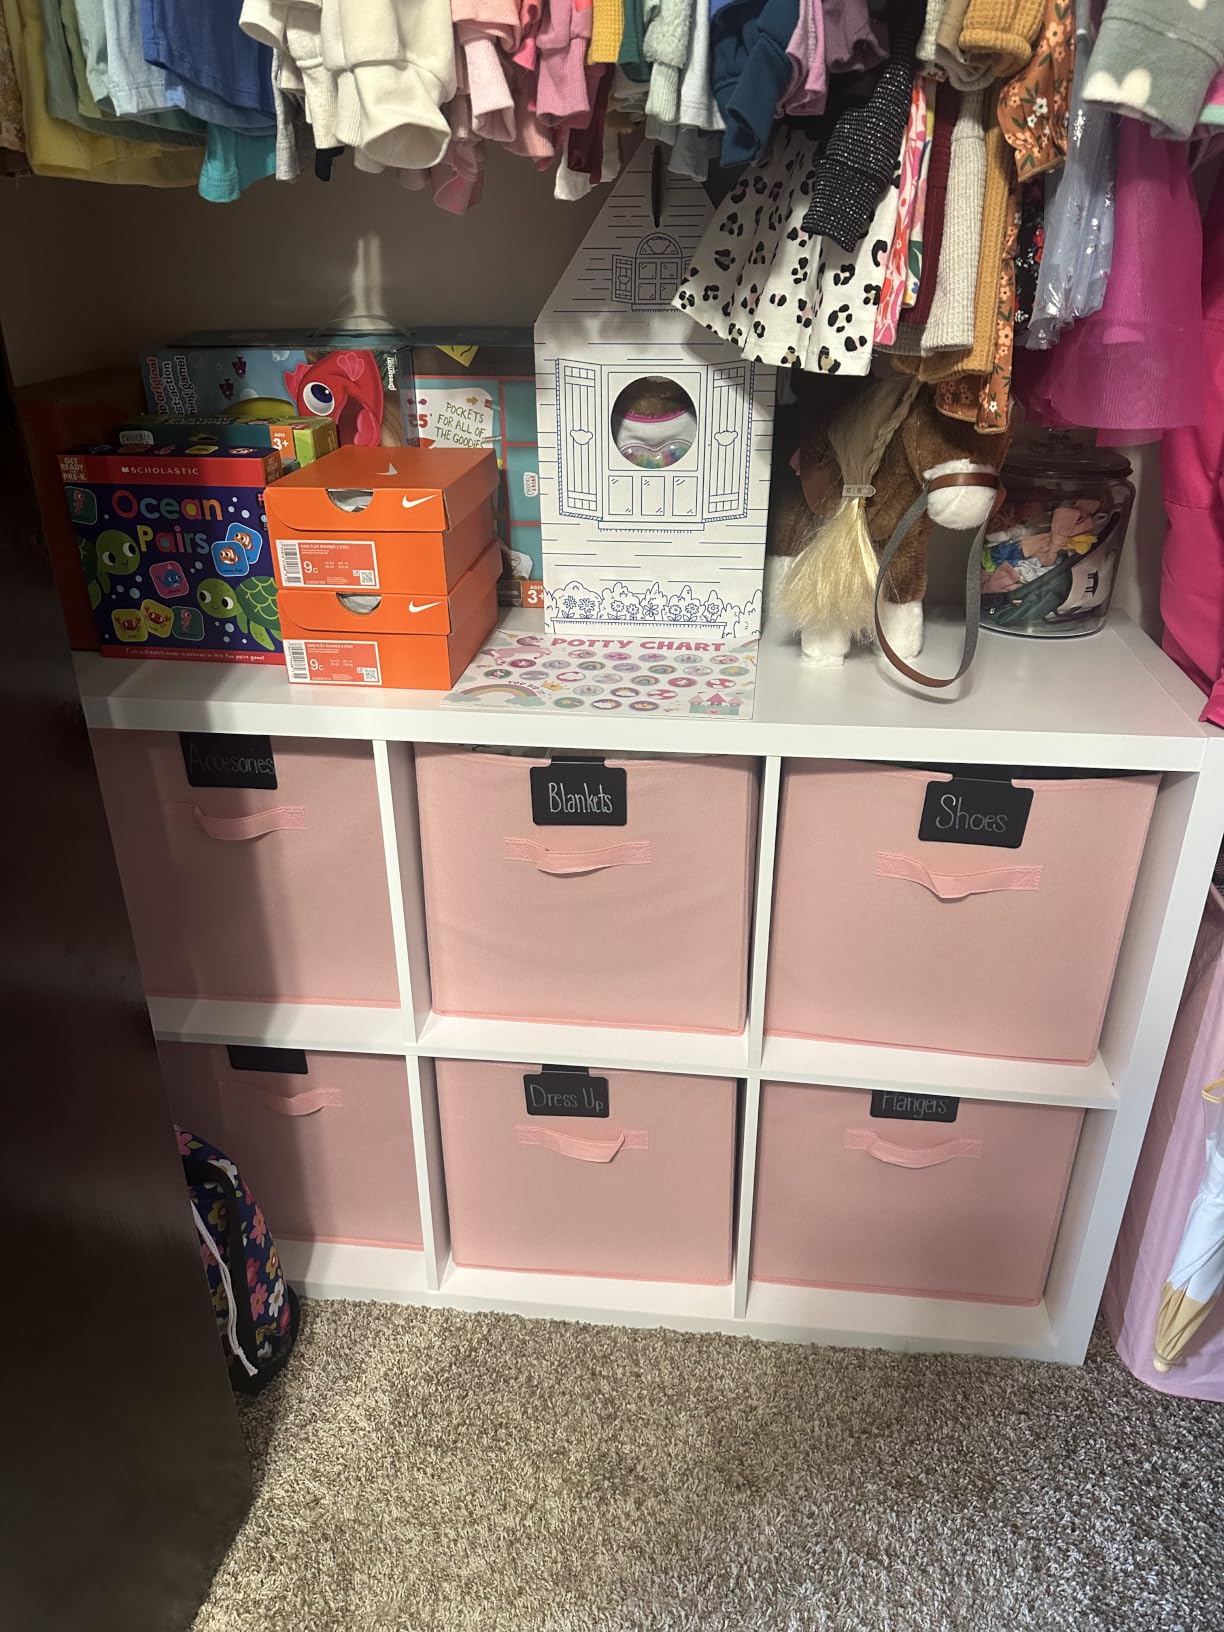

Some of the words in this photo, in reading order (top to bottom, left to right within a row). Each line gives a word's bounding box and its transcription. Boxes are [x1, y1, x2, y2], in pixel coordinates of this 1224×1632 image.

[446, 402, 485, 423] POCKETS
[435, 426, 451, 440] THE
[437, 413, 453, 427] FOR
[455, 421, 471, 434] ALL
[475, 427, 486, 438] OF
[273, 438, 289, 450] 3+
[131, 467, 199, 475] SCHOLASTIC
[112, 490, 223, 520] Ocean
[136, 524, 210, 554] Pairs
[550, 637, 633, 649] POTTY
[640, 640, 726, 652] CHART
[548, 782, 613, 813] Blankets
[936, 794, 1008, 832] Shoes
[530, 1084, 578, 1108] Dress
[583, 1088, 604, 1113] Up
